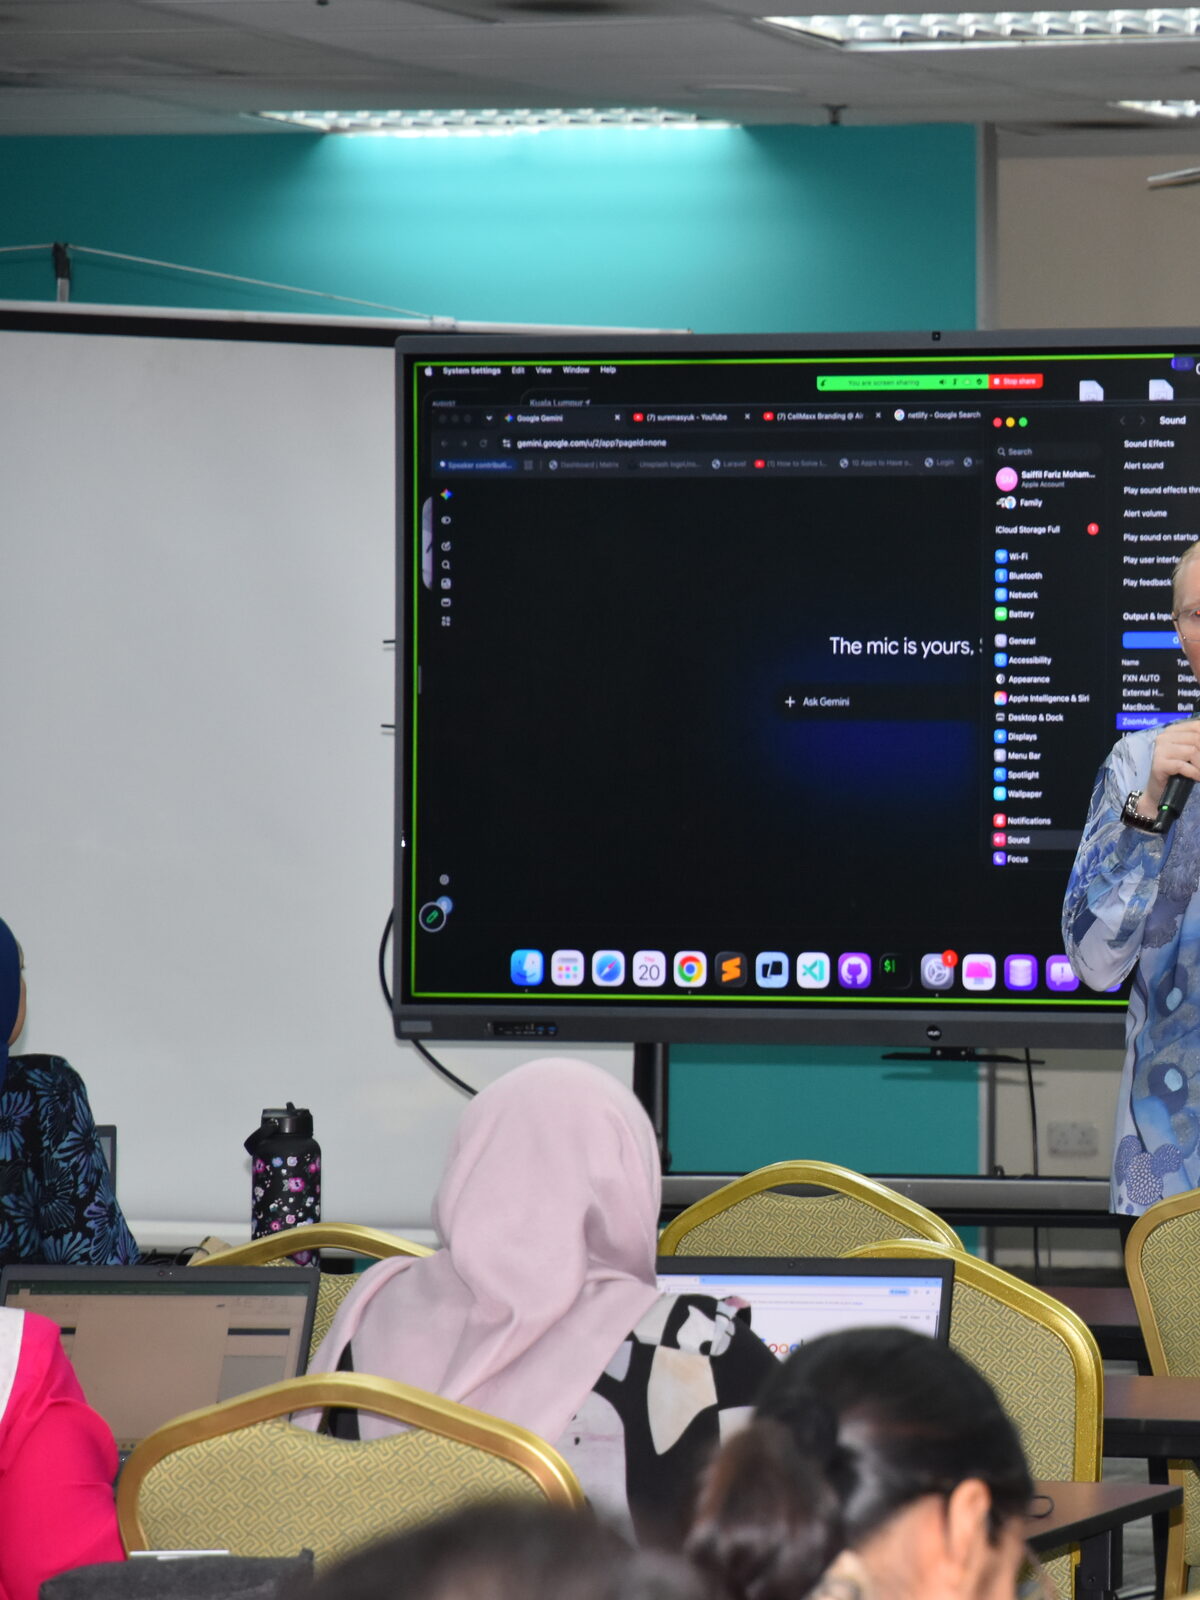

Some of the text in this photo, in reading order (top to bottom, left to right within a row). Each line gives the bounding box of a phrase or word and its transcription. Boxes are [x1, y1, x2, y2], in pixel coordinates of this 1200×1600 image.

[443, 366, 501, 376] System Settings
[511, 366, 525, 375] Edit
[535, 366, 552, 375] View
[562, 365, 590, 375] Window
[600, 365, 617, 376] Help
[1003, 377, 1036, 386] Stop share
[517, 414, 563, 424] Google Gemini
[817, 412, 846, 421] Branding
[934, 411, 957, 420] Google
[958, 411, 981, 419] Search
[1159, 416, 1187, 425] Sound
[1124, 439, 1175, 448] Sound Effects
[1008, 448, 1032, 456] Search
[1124, 461, 1164, 469] Alert sound
[1021, 481, 1038, 489] Apple
[1123, 486, 1138, 495] Play
[1140, 486, 1161, 494] sound
[1162, 486, 1187, 494] effects
[1020, 498, 1043, 508] Family
[1123, 509, 1168, 518] Alert volume
[995, 525, 1061, 535] iCloud Storage Full
[1123, 533, 1138, 542] Play
[1139, 533, 1161, 541] sound
[1173, 533, 1199, 542] startup
[1009, 552, 1029, 561] Wi-Fi
[1123, 556, 1138, 565] Play
[1156, 555, 1182, 564] interfa
[1009, 571, 1043, 581] Bluetooth
[1123, 578, 1172, 588] Play feedback
[1009, 591, 1039, 599] Network
[1008, 610, 1034, 620] Battery
[1123, 612, 1173, 621] Output & Inpu
[1008, 637, 1036, 646] General
[829, 636, 862, 654] The
[866, 636, 899, 654] mic
[903, 636, 917, 654] is
[921, 640, 975, 659] yours,
[1008, 656, 1052, 665] Accessibility
[1008, 675, 1050, 685] Appearance
[1139, 674, 1160, 682] AUTO
[1122, 689, 1151, 697] External
[803, 696, 850, 706] Ask Gemini
[1008, 694, 1090, 704] Apple Intelligence & Siri
[1008, 713, 1064, 722] Desktop & Dock
[1008, 732, 1037, 742] Displays
[1008, 752, 1041, 760] Menu Bar
[1008, 770, 1039, 781] Spotlight
[1008, 790, 1042, 799] Wallpaper
[1007, 816, 1051, 826] Notifications
[1007, 836, 1030, 845] Sound
[1007, 855, 1029, 864] Focus
[639, 964, 660, 981] 20
